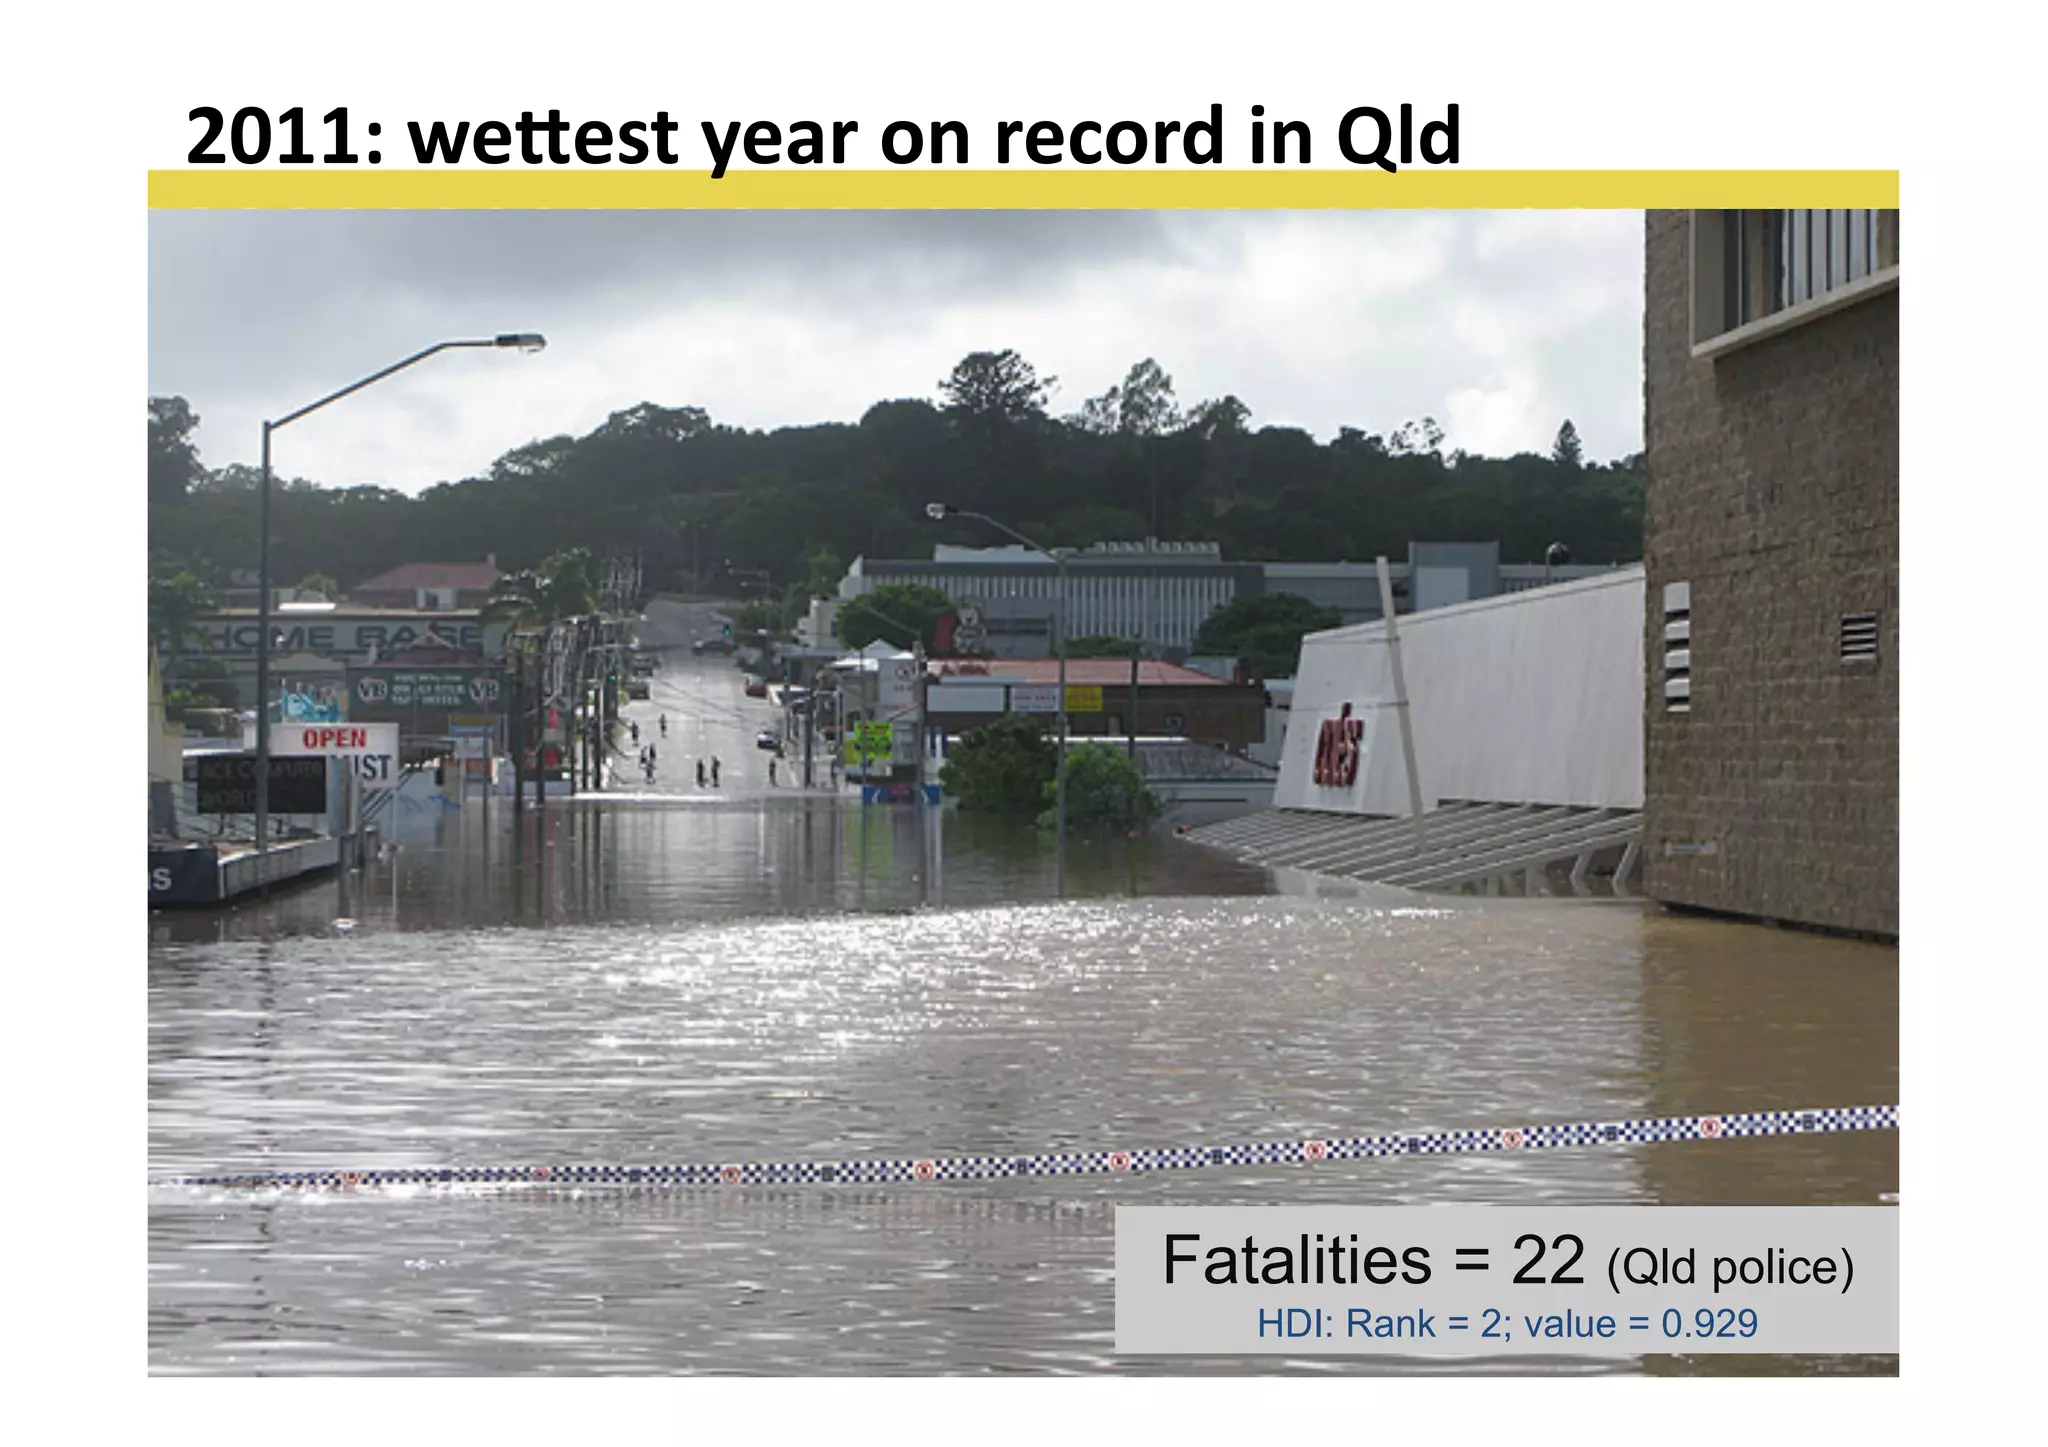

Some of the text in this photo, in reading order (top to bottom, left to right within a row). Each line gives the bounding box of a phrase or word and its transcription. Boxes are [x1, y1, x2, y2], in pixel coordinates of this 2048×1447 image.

[203, 626, 335, 649] HOME
[303, 728, 367, 749] OPEN
[148, 867, 171, 890] S
